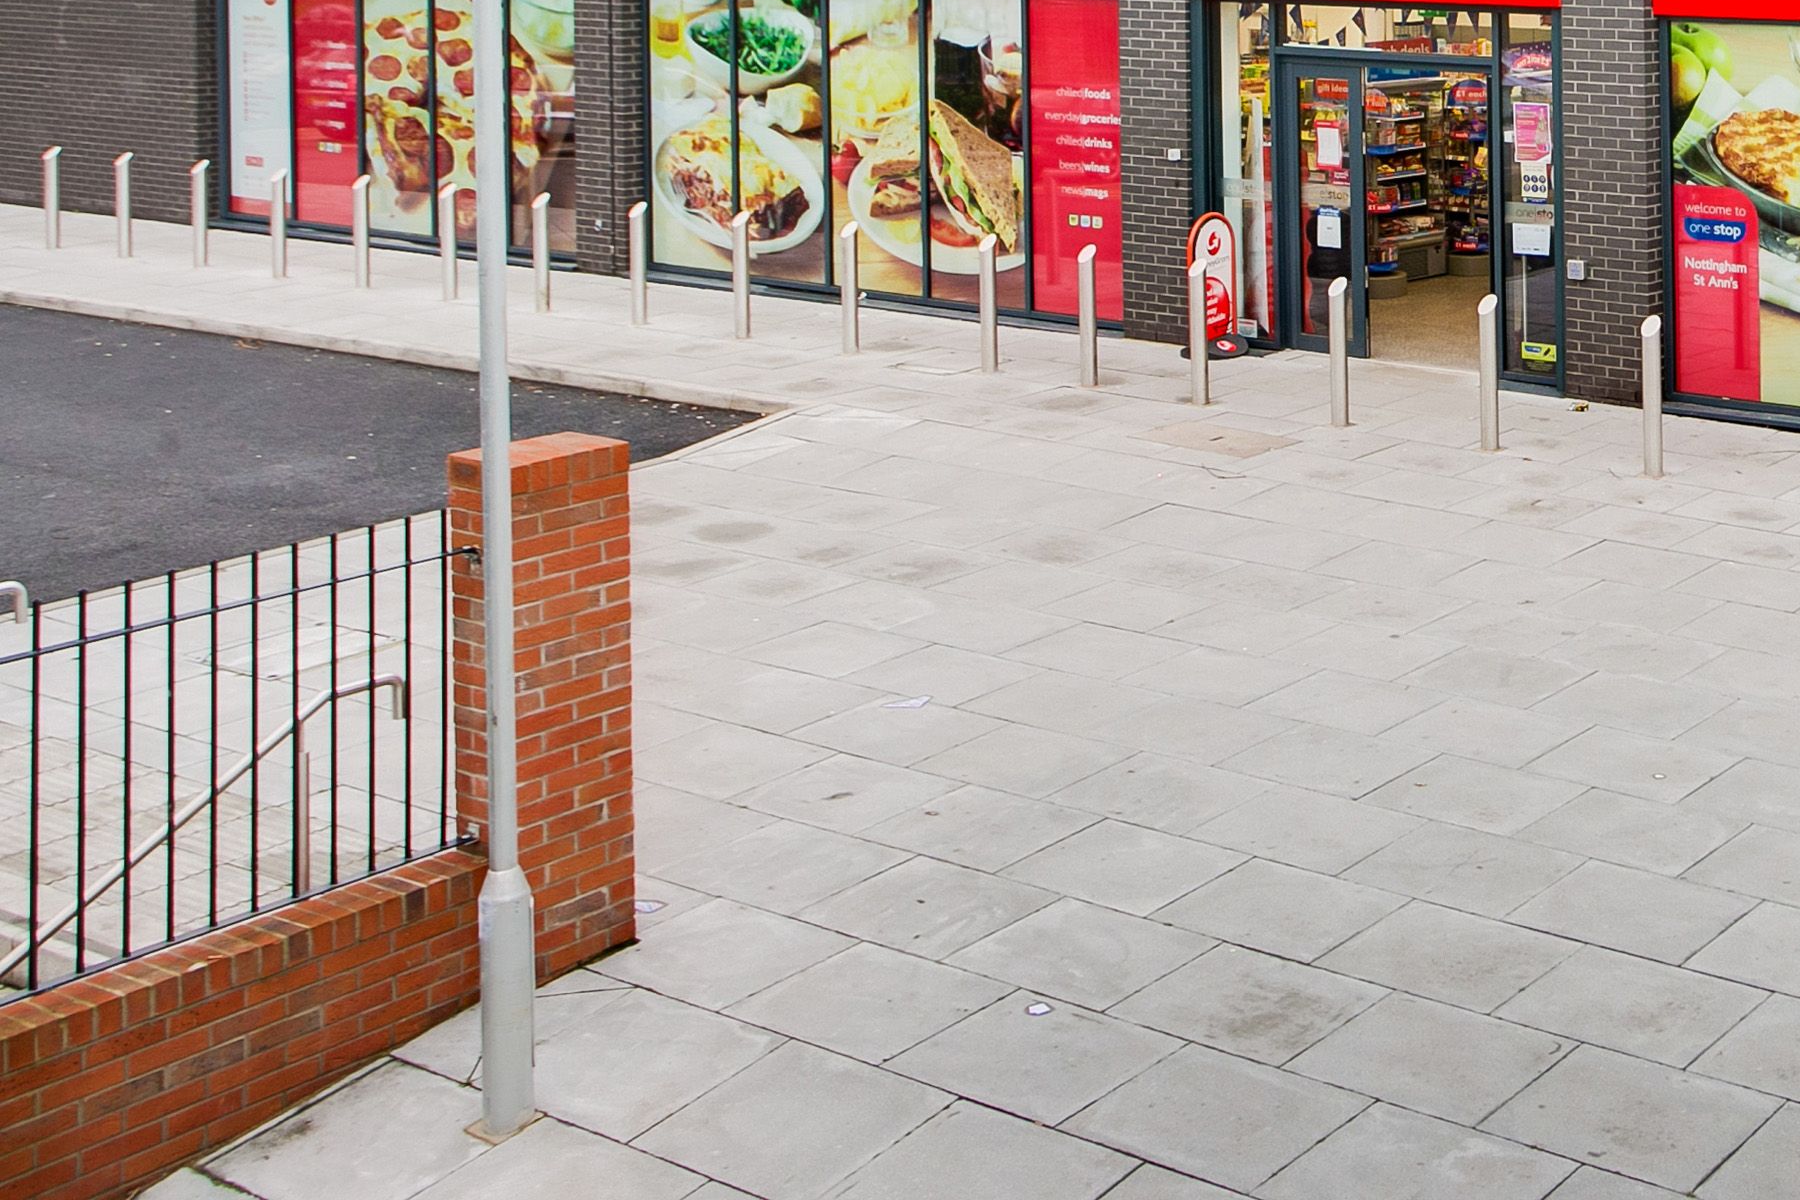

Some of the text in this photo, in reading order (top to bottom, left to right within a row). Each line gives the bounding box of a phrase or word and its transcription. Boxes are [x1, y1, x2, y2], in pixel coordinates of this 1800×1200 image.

[1331, 81, 1349, 93] idea
[1084, 88, 1112, 100] foods
[1084, 137, 1113, 149] drinks
[1083, 161, 1110, 174] wines
[1536, 208, 1554, 220] sto
[1684, 202, 1747, 217] welcome to
[1689, 223, 1742, 240] one stop
[1684, 256, 1748, 274] Nottingham
[1693, 273, 1739, 290] St Ann's
